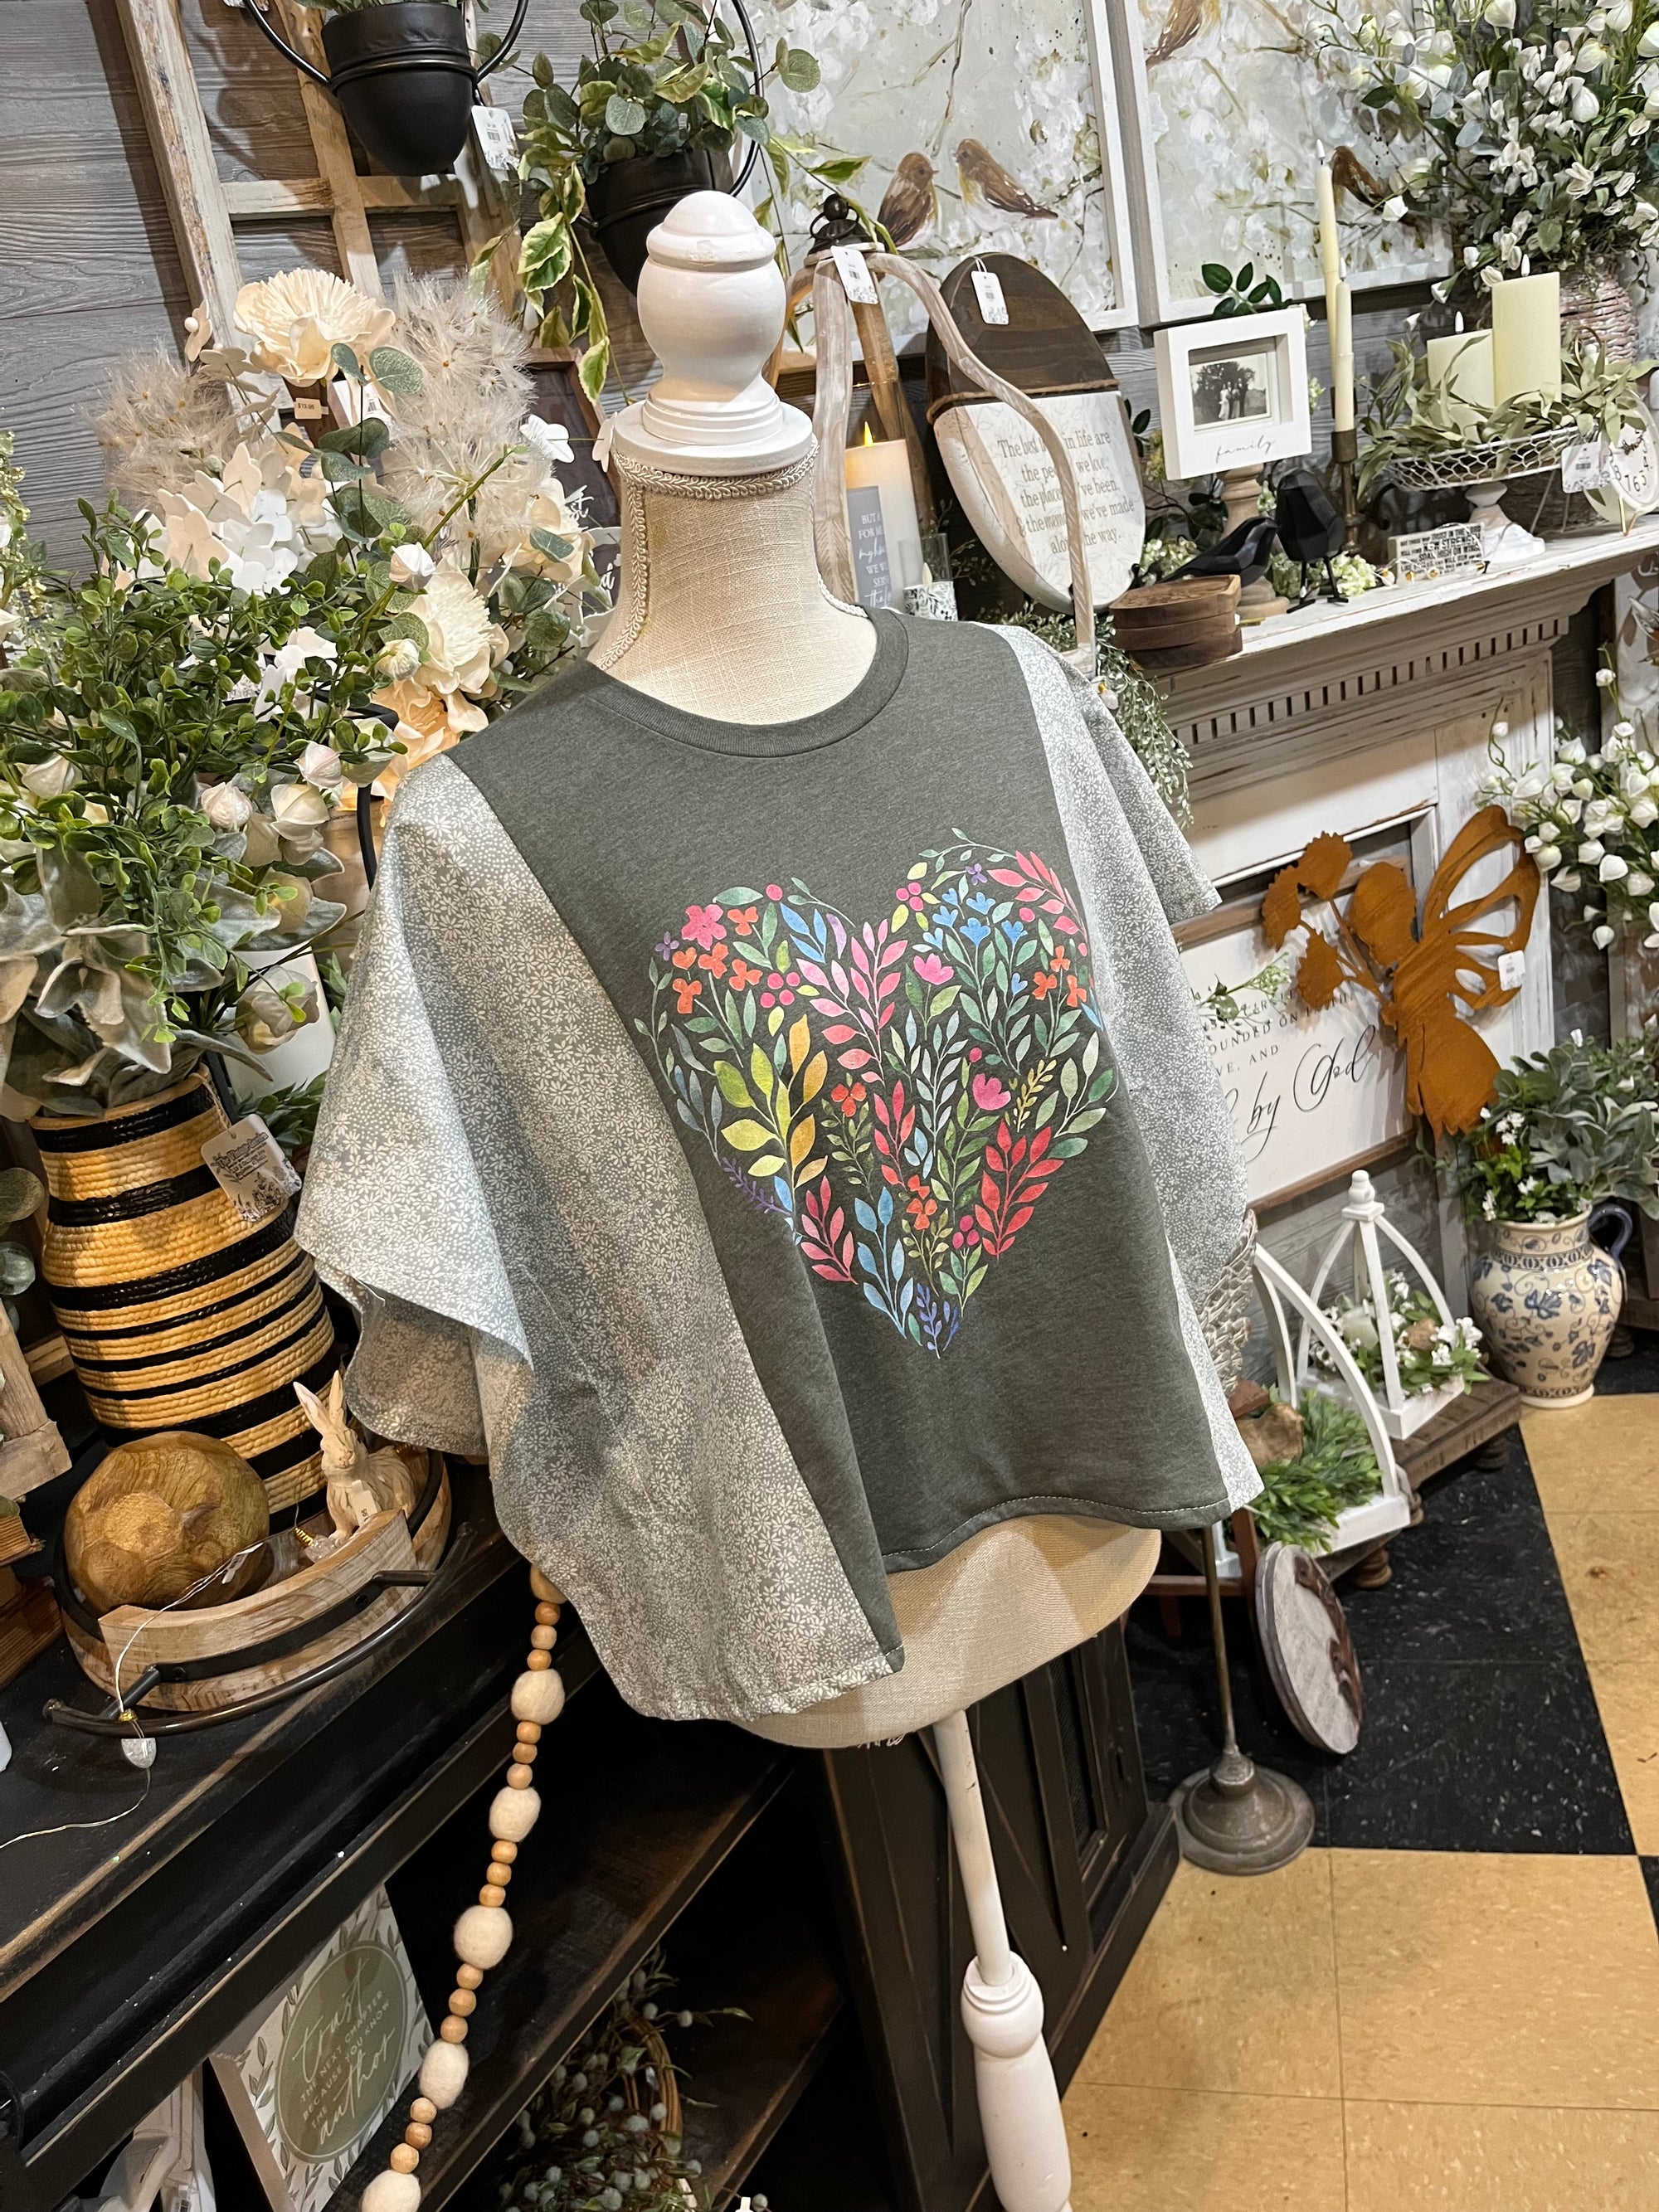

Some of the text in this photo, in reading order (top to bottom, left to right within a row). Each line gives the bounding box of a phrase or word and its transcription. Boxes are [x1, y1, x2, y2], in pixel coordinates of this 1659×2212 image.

[997, 439, 1022, 458] The
[1062, 431, 1076, 450] in
[1075, 430, 1093, 448] life
[1094, 431, 1111, 445] are
[1215, 435, 1277, 464] family
[1021, 464, 1039, 483] the
[1076, 459, 1090, 474] we
[1020, 489, 1039, 508] the
[861, 513, 877, 525] BUT
[1025, 514, 1045, 532] the
[1081, 503, 1107, 521] we've
[1109, 496, 1135, 515] made
[858, 527, 875, 540] FOR
[1050, 534, 1068, 555] alo
[865, 563, 880, 576] WE
[1209, 1023, 1272, 1055] OUNDED
[1279, 1011, 1298, 1028] ON
[1248, 1044, 1279, 1066] AND
[1246, 1023, 1377, 1163] by God
[292, 1957, 370, 2083] trust
[300, 1990, 382, 2103] THE NEXT CHAPTER
[303, 1999, 390, 2121] BECAUSE YOU KNOW
[320, 2027, 396, 2145] author
[311, 2105, 328, 2129] THE
